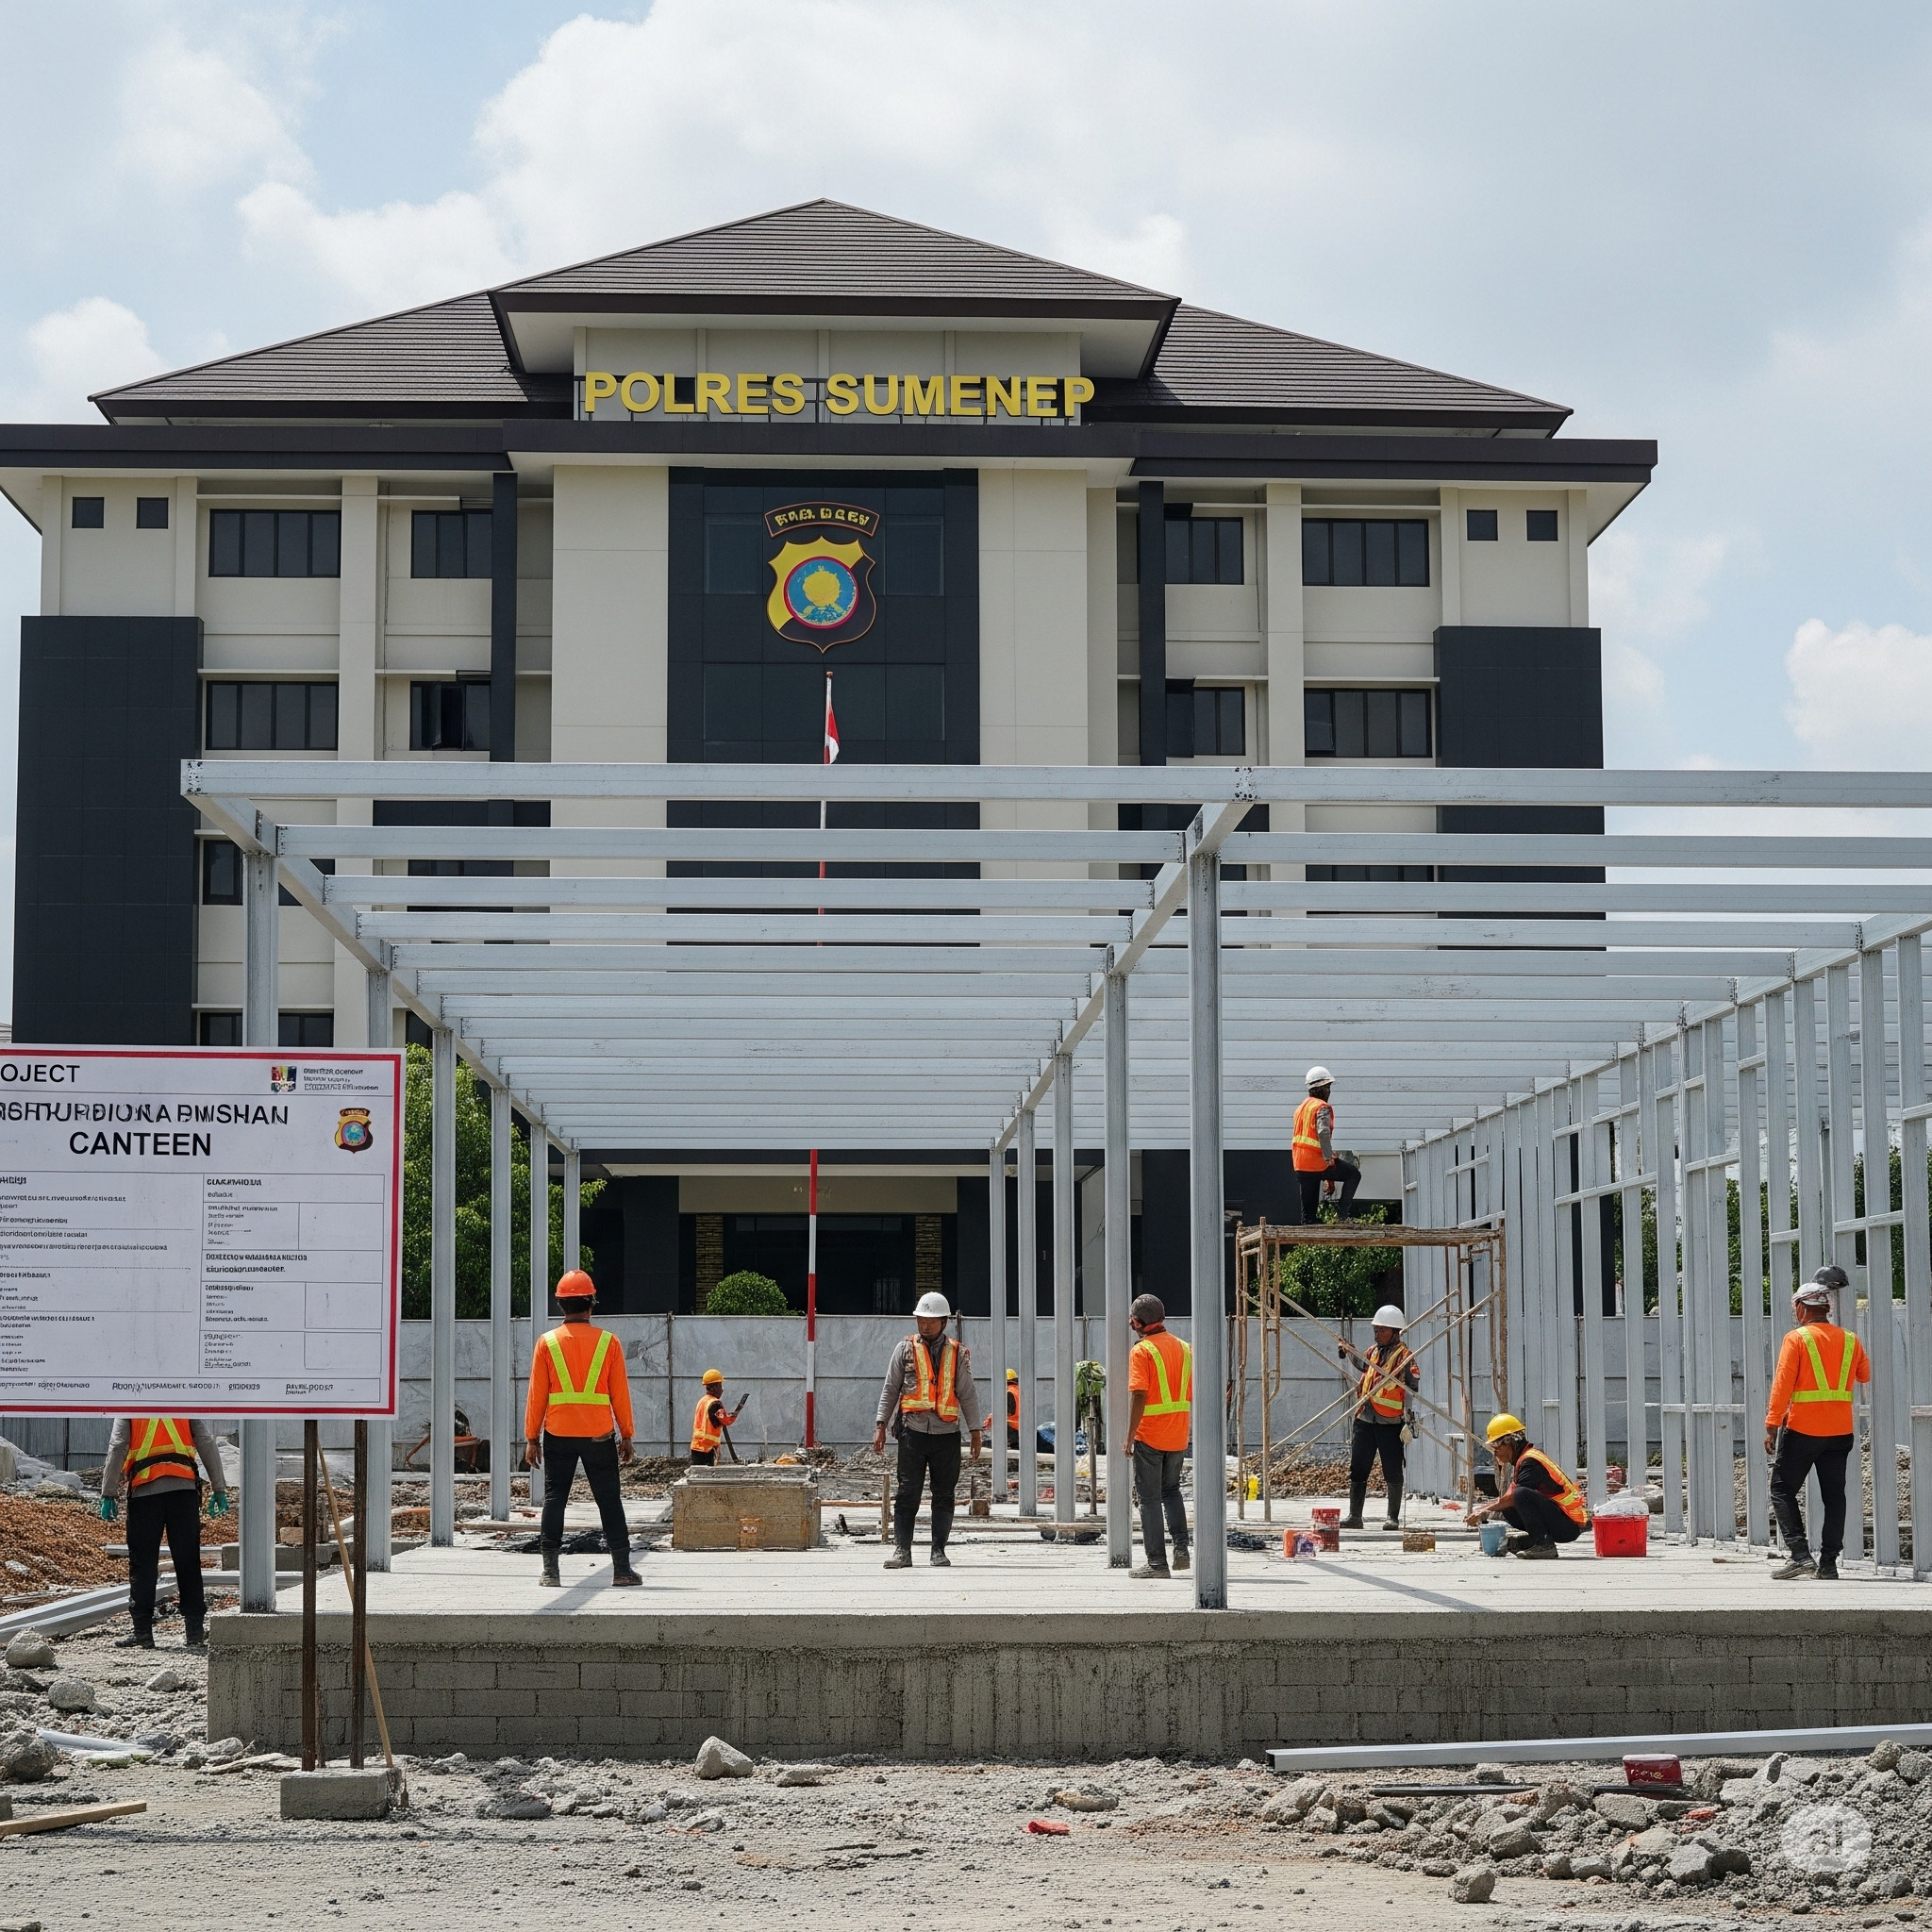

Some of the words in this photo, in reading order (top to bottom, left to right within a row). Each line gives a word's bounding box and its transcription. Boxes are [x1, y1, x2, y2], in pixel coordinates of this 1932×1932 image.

[584, 371, 806, 415] POLRES
[824, 373, 1095, 417] SUMENEP
[0, 1063, 81, 1083] OJECT
[69, 1131, 211, 1157] CANTEEN
